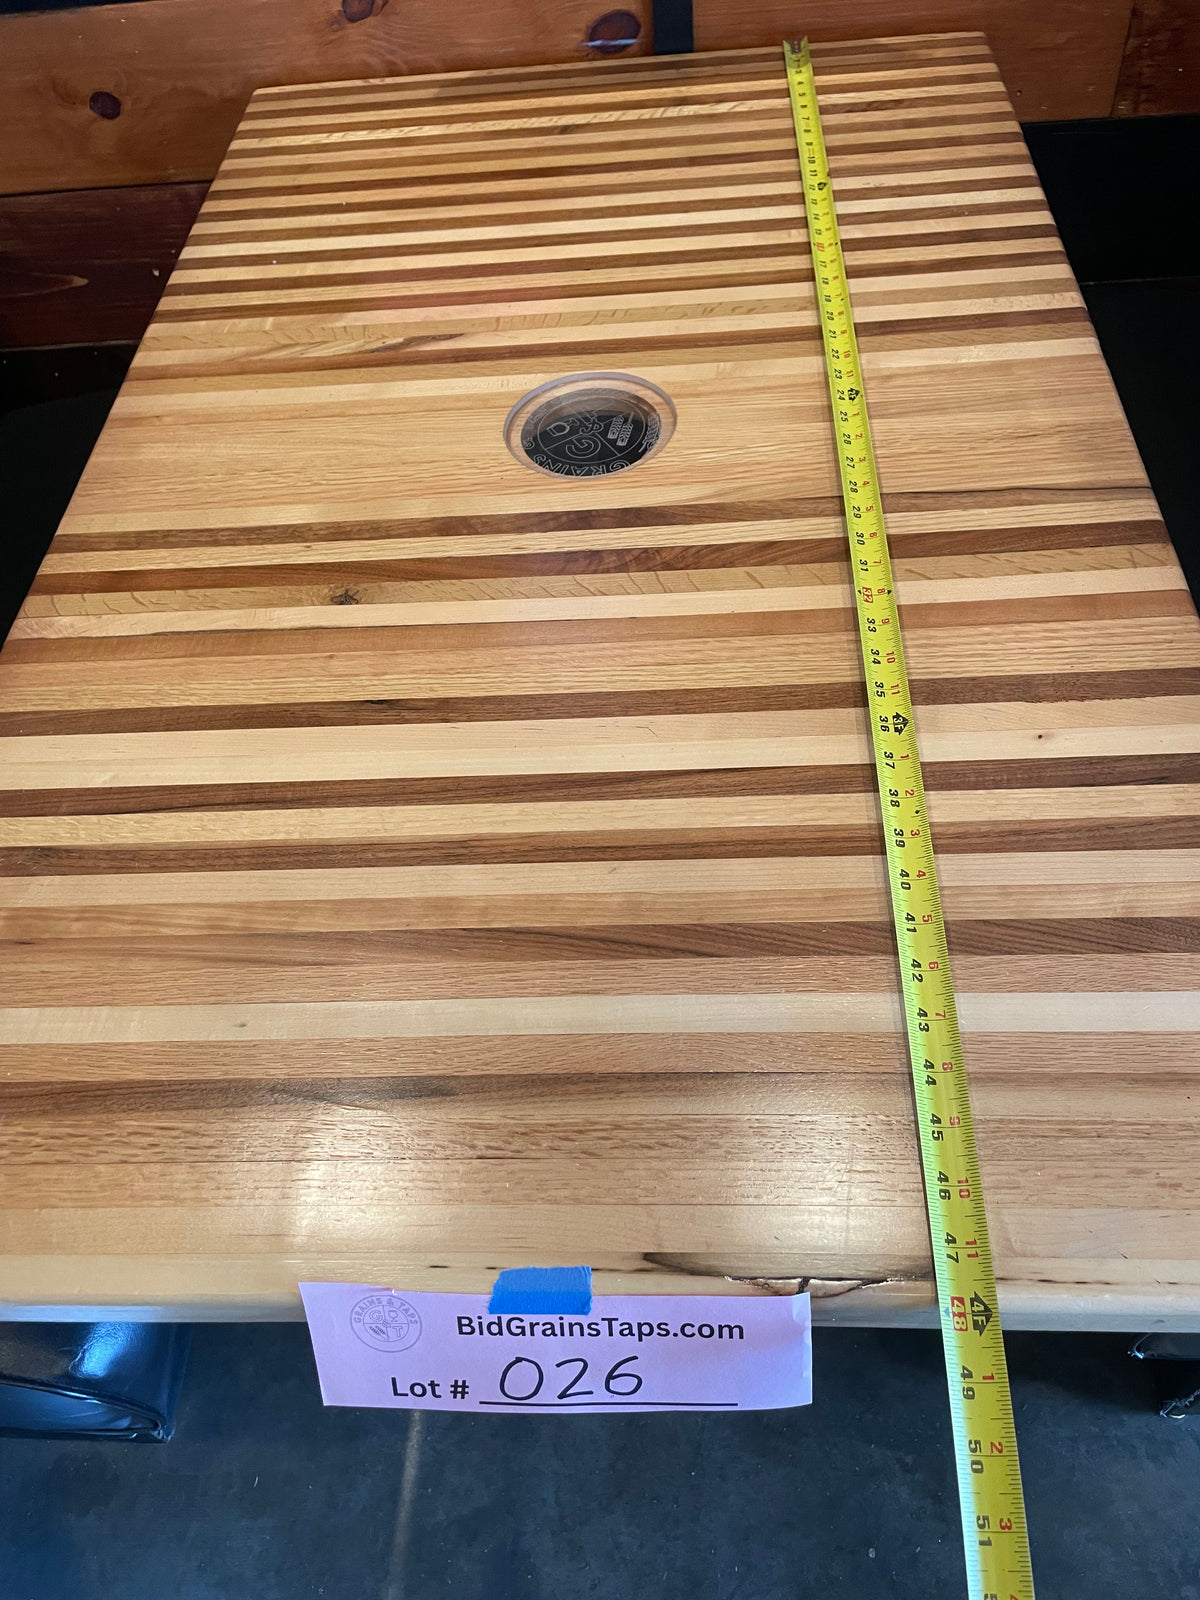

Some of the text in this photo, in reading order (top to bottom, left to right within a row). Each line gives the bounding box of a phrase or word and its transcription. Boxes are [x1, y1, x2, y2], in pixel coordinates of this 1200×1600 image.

[819, 260, 827, 268] 17
[826, 311, 834, 320] 20
[829, 330, 837, 339] 21
[831, 348, 840, 359] 22
[834, 368, 843, 379] 23
[846, 369, 854, 378] 11
[837, 389, 845, 400] 24
[840, 410, 849, 422] 25
[566, 435, 601, 459] G
[842, 433, 851, 445] 26
[846, 456, 855, 469] 27
[849, 480, 858, 493] 28
[852, 505, 862, 519] 29
[856, 532, 865, 545] 30
[859, 559, 869, 572] 31
[862, 587, 873, 603] 32
[866, 617, 877, 633] 33
[870, 648, 881, 665] 34
[886, 650, 896, 664] 10
[874, 681, 886, 698] 35
[890, 684, 900, 695] 11
[879, 715, 890, 733] 36
[883, 751, 896, 770] 37
[888, 788, 901, 808] 38
[904, 789, 915, 797] 2
[893, 828, 906, 848] 39
[910, 828, 921, 837] 3
[899, 868, 912, 891] 40
[916, 869, 927, 879] 4
[905, 912, 917, 934] 41
[922, 914, 933, 923] 5
[911, 958, 924, 983] 42
[928, 961, 939, 970] 6
[917, 1007, 930, 1033] 43
[935, 1010, 946, 1019] 7
[923, 1058, 937, 1086] 44
[942, 1061, 953, 1071] 8
[930, 1113, 944, 1142] 45
[937, 1170, 951, 1201] 46
[957, 1177, 970, 1199] 10
[944, 1232, 960, 1264] 47
[965, 1238, 979, 1259] 11
[353, 1298, 383, 1324] GRAINS
[399, 1302, 418, 1325] TAPS
[952, 1299, 967, 1330] 48
[970, 1302, 986, 1328] 4F
[369, 1310, 383, 1322] G
[392, 1326, 403, 1338] T
[456, 1315, 745, 1343] BidGrainsTaps.com
[391, 1355, 643, 1401] Lot # 026
[960, 1365, 976, 1401] 49
[982, 1372, 995, 1381] 1
[990, 1441, 1004, 1454] 2
[968, 1439, 984, 1475] 50
[976, 1515, 993, 1547] 51
[999, 1517, 1013, 1531] 3
